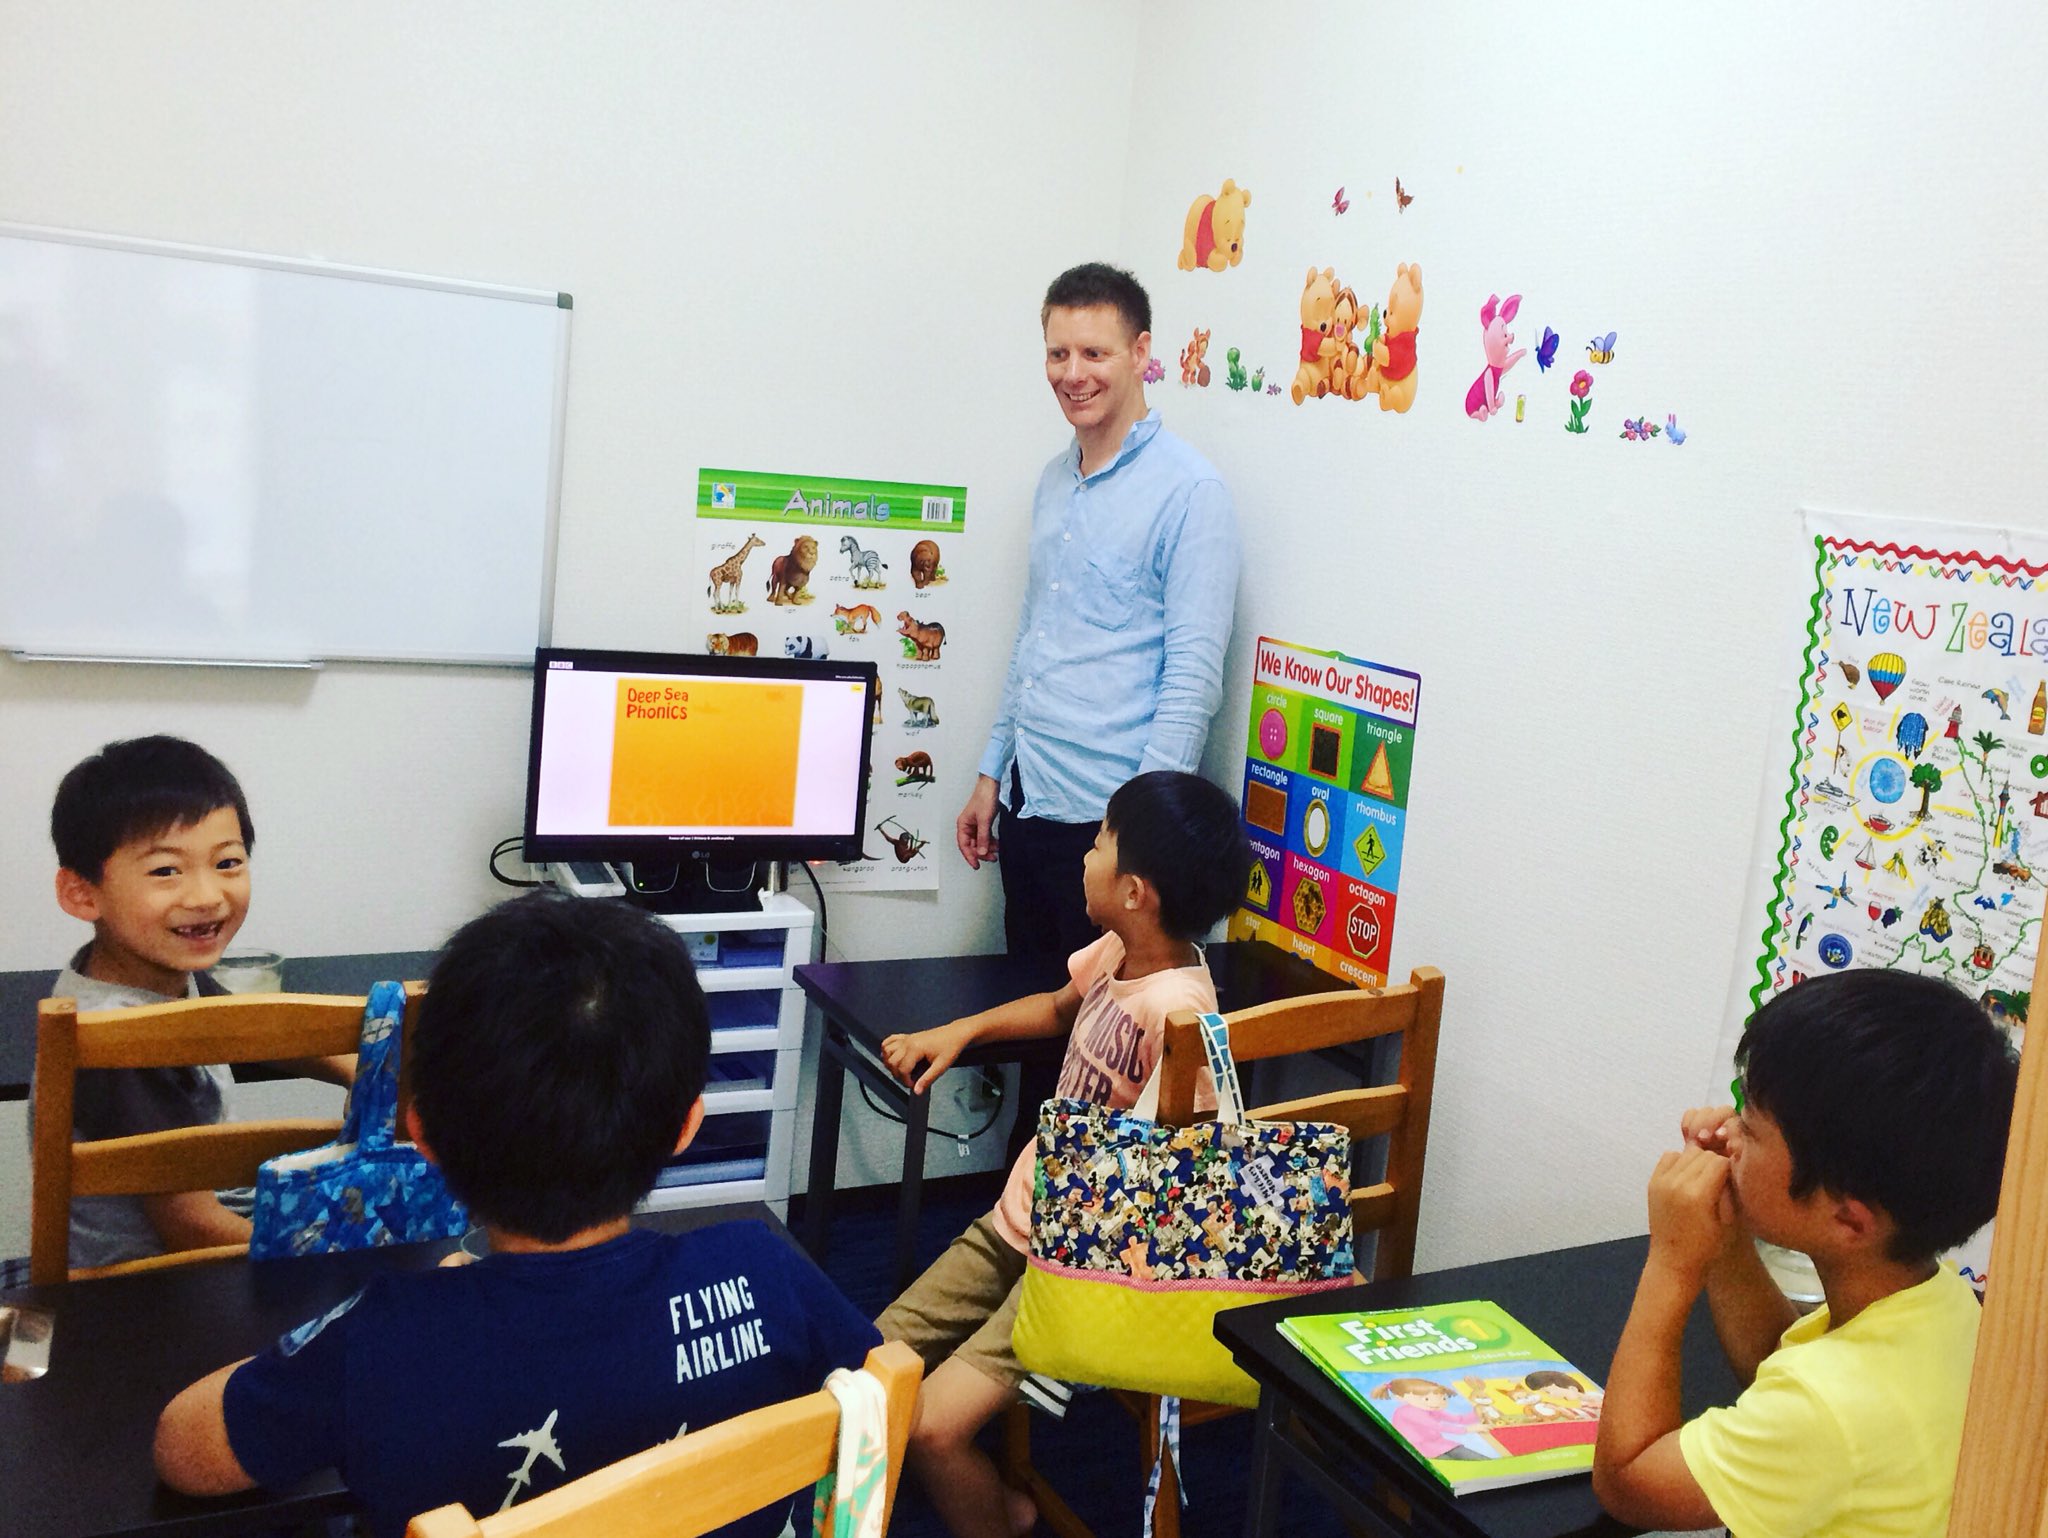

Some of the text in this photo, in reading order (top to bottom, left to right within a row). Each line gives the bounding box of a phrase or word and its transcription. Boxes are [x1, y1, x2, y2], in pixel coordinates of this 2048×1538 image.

[784, 489, 890, 521] Animals
[1261, 649, 1415, 713] We Know Our Shapes!
[627, 687, 689, 703] Deep Sea
[1266, 693, 1287, 708] circle
[627, 703, 688, 720] Phonics
[1313, 707, 1344, 726] square
[1366, 721, 1402, 744] triangle
[1251, 763, 1288, 785] rectangle
[1311, 784, 1330, 801] oval
[1356, 802, 1398, 826] rhombus
[1249, 840, 1281, 861] ntagon
[1293, 856, 1330, 883] hexagon
[1348, 882, 1386, 907] octagon
[1244, 914, 1262, 930] star
[1350, 916, 1378, 943] STOP
[1292, 934, 1316, 957] heart
[1339, 960, 1378, 988] crescent
[1083, 998, 1146, 1084] MUSIC
[1255, 1162, 1276, 1195] Mouse
[669, 1275, 755, 1335] FLYING
[1339, 1318, 1490, 1344] First 1
[676, 1318, 771, 1384] AIRLINE
[1344, 1336, 1479, 1365] Friends
